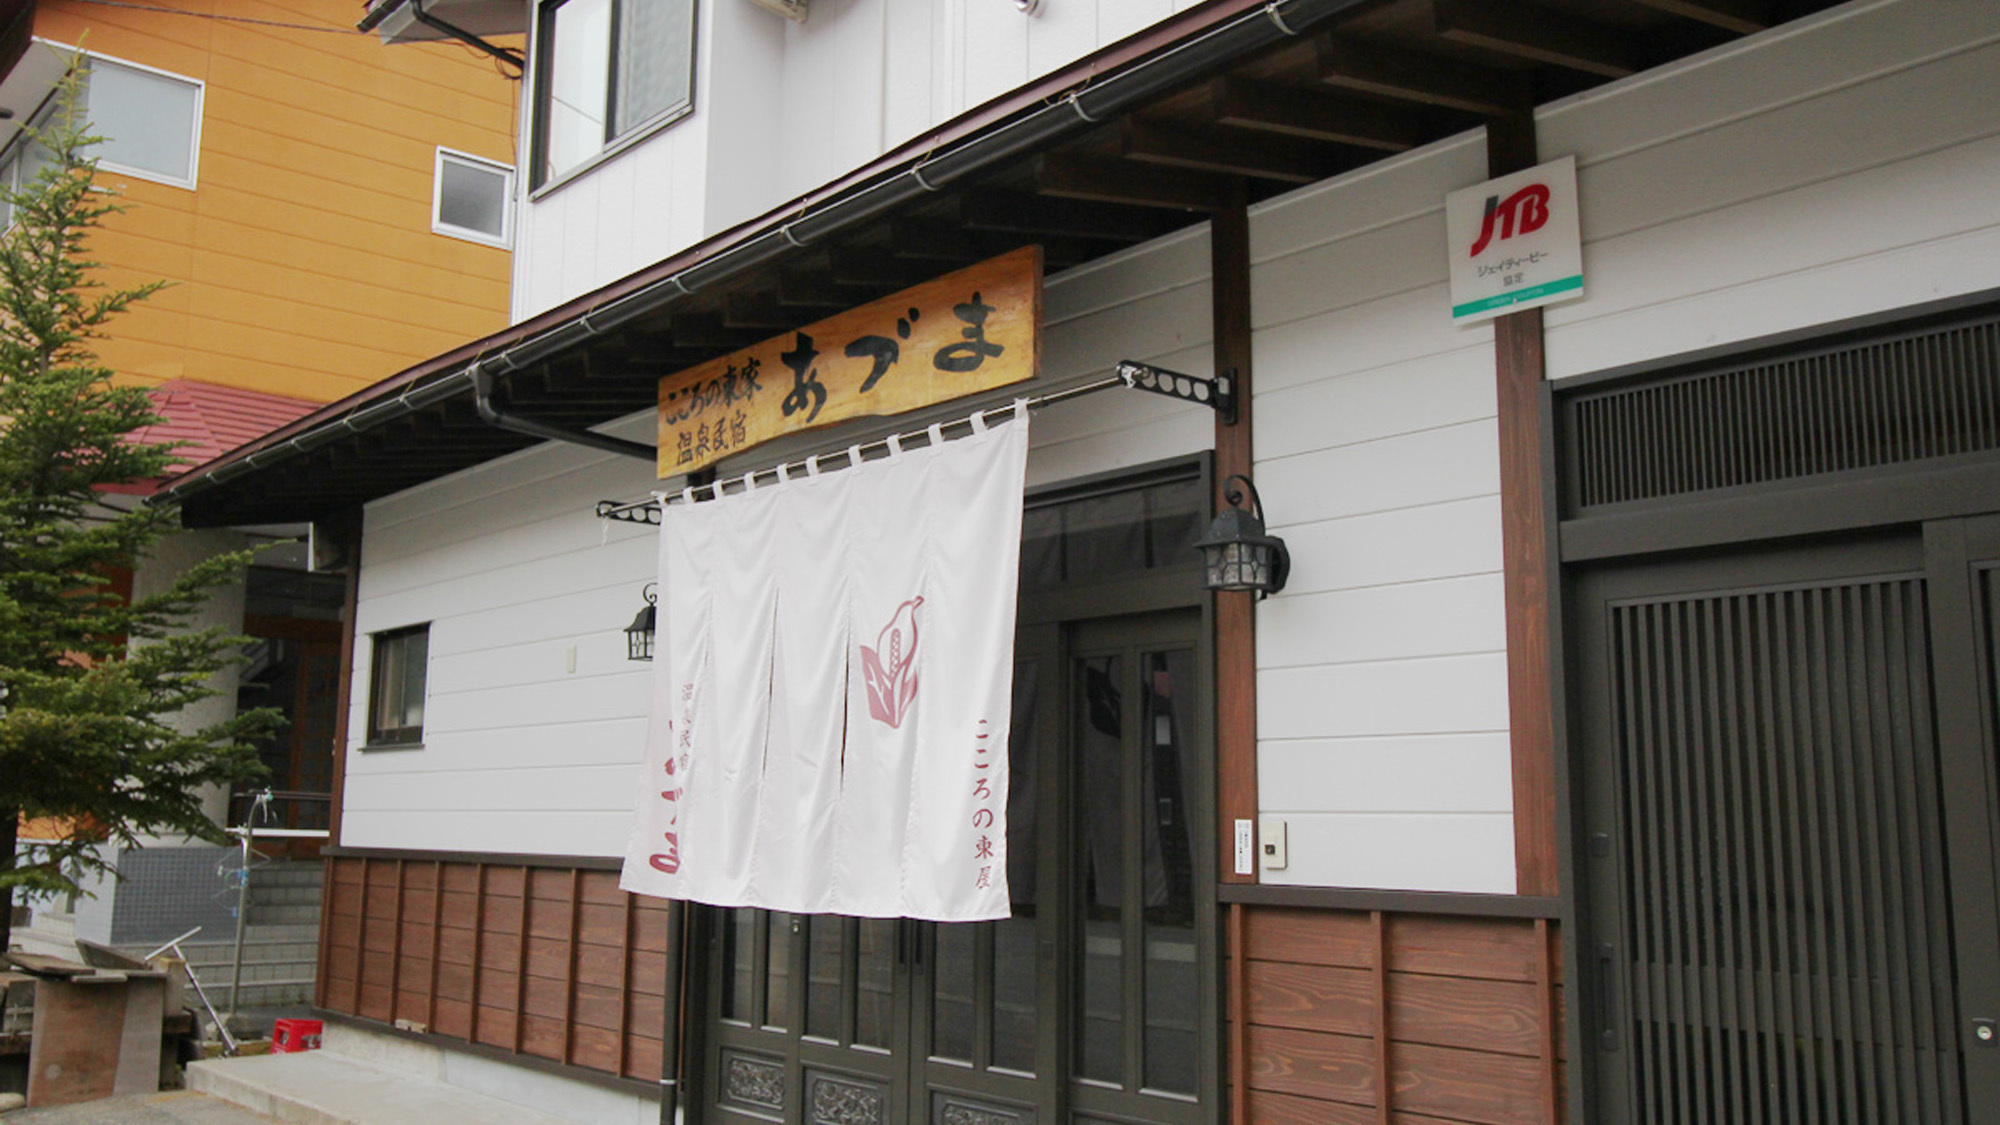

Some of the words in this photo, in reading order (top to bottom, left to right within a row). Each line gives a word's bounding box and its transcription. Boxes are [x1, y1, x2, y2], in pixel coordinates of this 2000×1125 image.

[1470, 183, 1550, 258] JTB
[1477, 251, 1549, 278] ジェイティービー
[666, 356, 764, 426] こころの東家
[781, 290, 1005, 424] あづま
[676, 408, 747, 467] 温泉民宿
